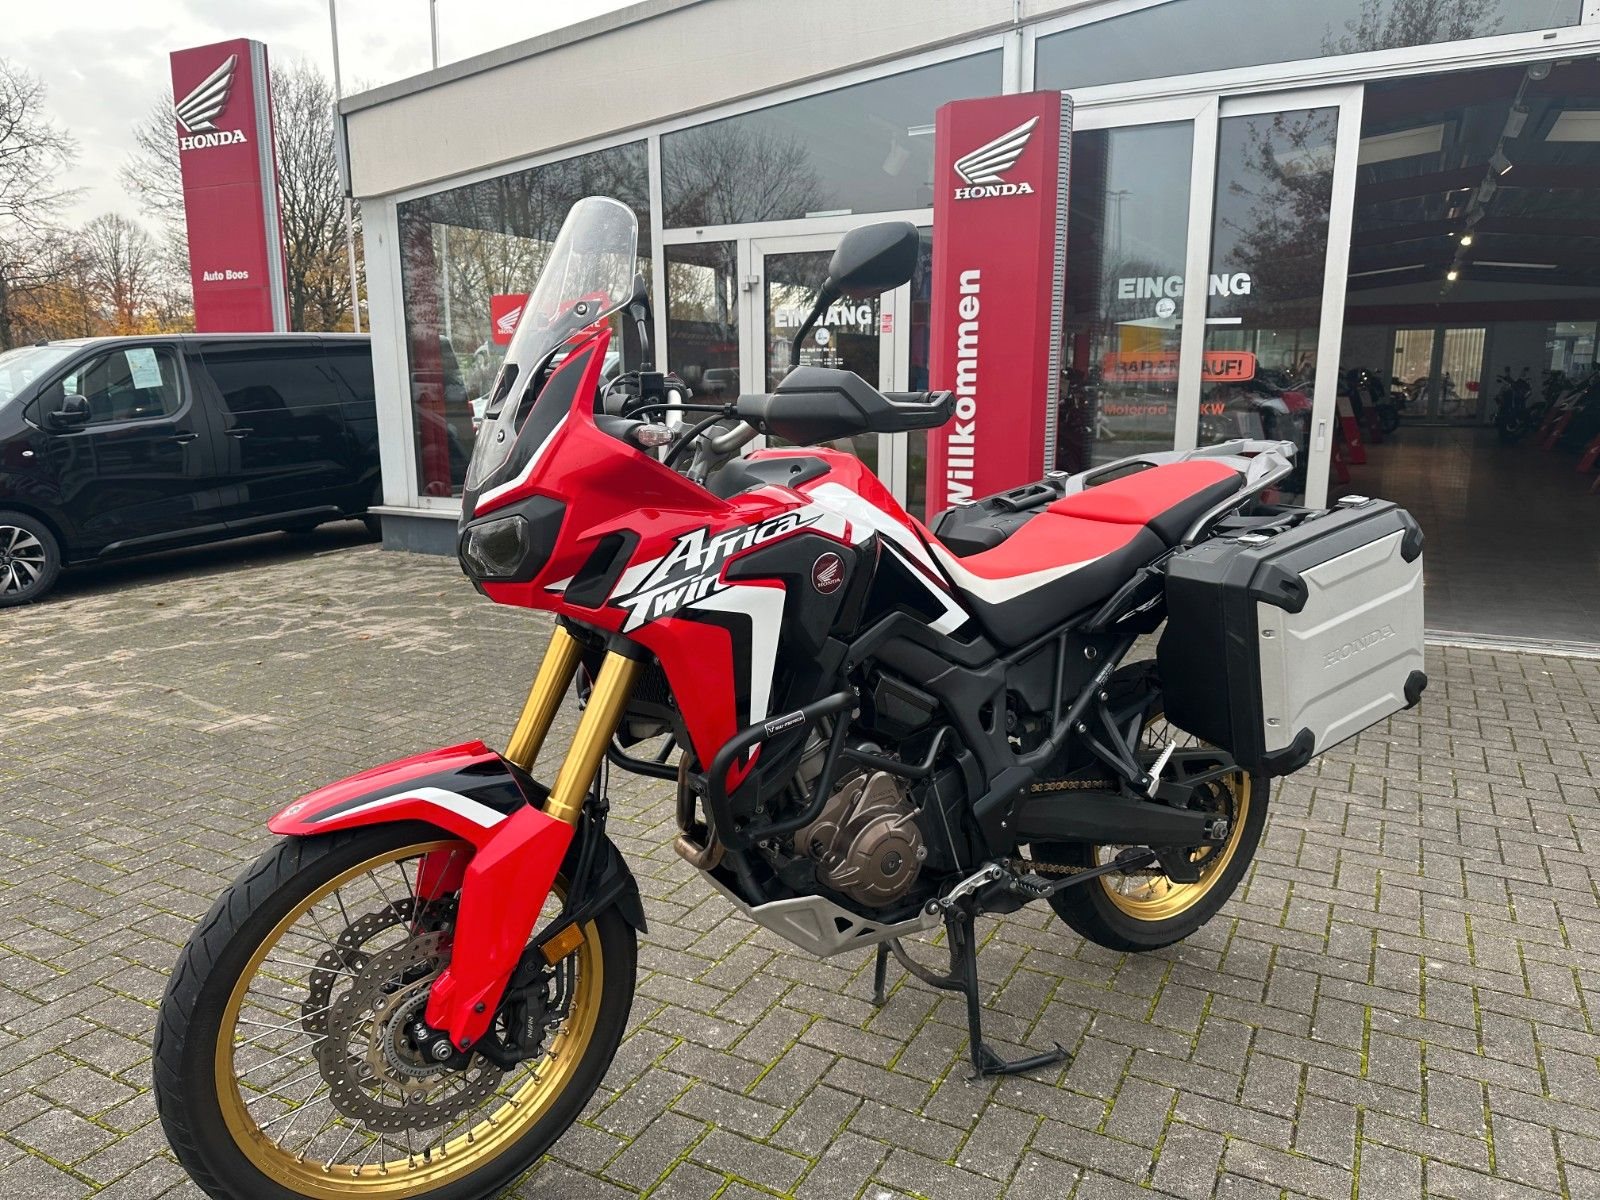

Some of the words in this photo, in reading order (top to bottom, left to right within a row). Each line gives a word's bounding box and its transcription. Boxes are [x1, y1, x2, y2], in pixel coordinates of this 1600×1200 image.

[180, 129, 248, 151] HONDA
[954, 182, 1035, 200] HONDA
[203, 270, 224, 282] Auto
[225, 269, 249, 281] Boos
[1118, 273, 1251, 299] EINGNG
[947, 269, 981, 511] Willkommen
[1104, 402, 1168, 416] Motorrad
[637, 513, 825, 594] Africa
[817, 577, 841, 588] HONDA
[618, 571, 733, 634] Twin
[1321, 623, 1397, 669] HONDA
